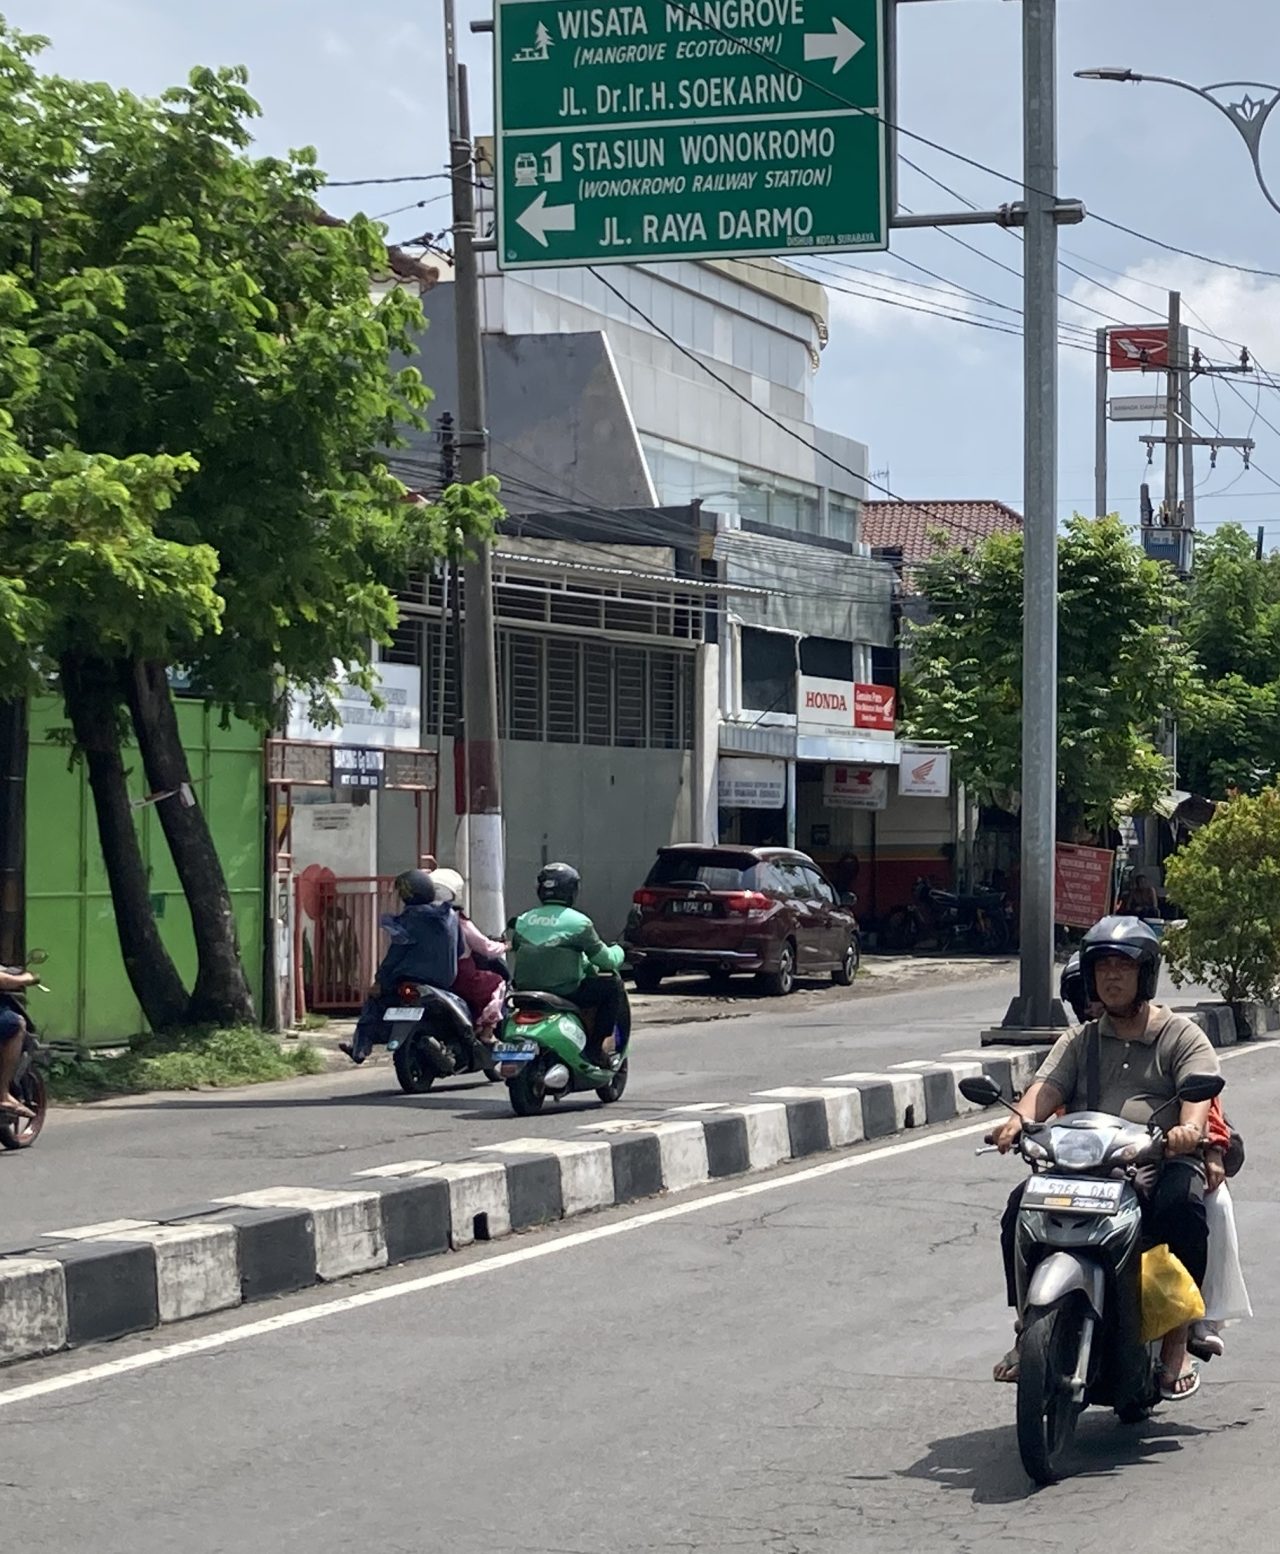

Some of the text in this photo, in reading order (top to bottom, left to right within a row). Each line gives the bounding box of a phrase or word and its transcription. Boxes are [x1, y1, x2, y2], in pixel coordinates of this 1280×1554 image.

[557, 0, 804, 40] WISATA MANGROVE
[573, 33, 782, 69] (MANGROVE ECOTOURISM)
[559, 87, 587, 116] JL.
[679, 73, 802, 109] SOEKARNO
[572, 127, 835, 172] STASIUN WONOKROMO
[579, 165, 832, 201] (WONOKROMO RAILWAY STATION)
[599, 207, 813, 246] JL. RAYA DARMO
[816, 234, 835, 245] KOTA
[837, 232, 875, 244] SURABAYA
[806, 691, 847, 711] HONDA
[528, 914, 559, 926] Grab
